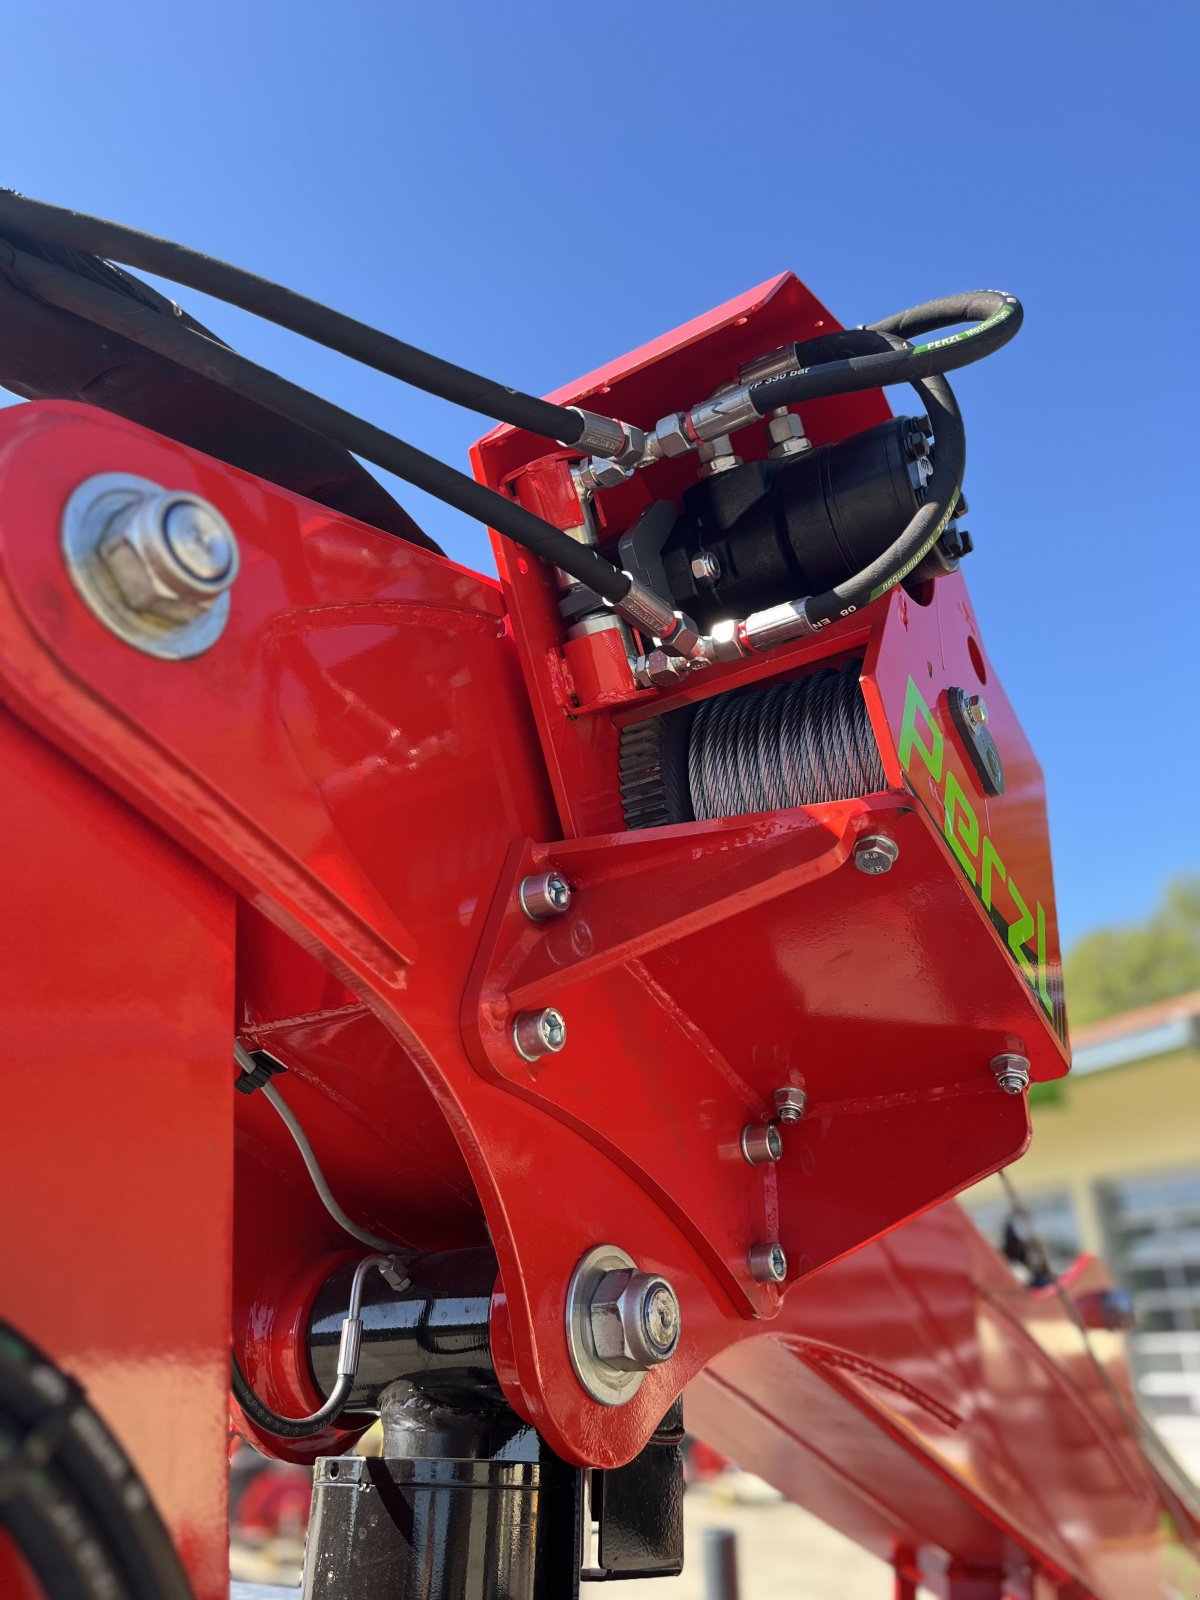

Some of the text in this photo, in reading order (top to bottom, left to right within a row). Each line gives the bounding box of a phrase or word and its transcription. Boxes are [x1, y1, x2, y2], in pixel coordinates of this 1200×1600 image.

[926, 333, 963, 350] PERZL
[789, 366, 811, 377] bar
[881, 536, 936, 591] Maschinenbau
[812, 618, 831, 629] EN
